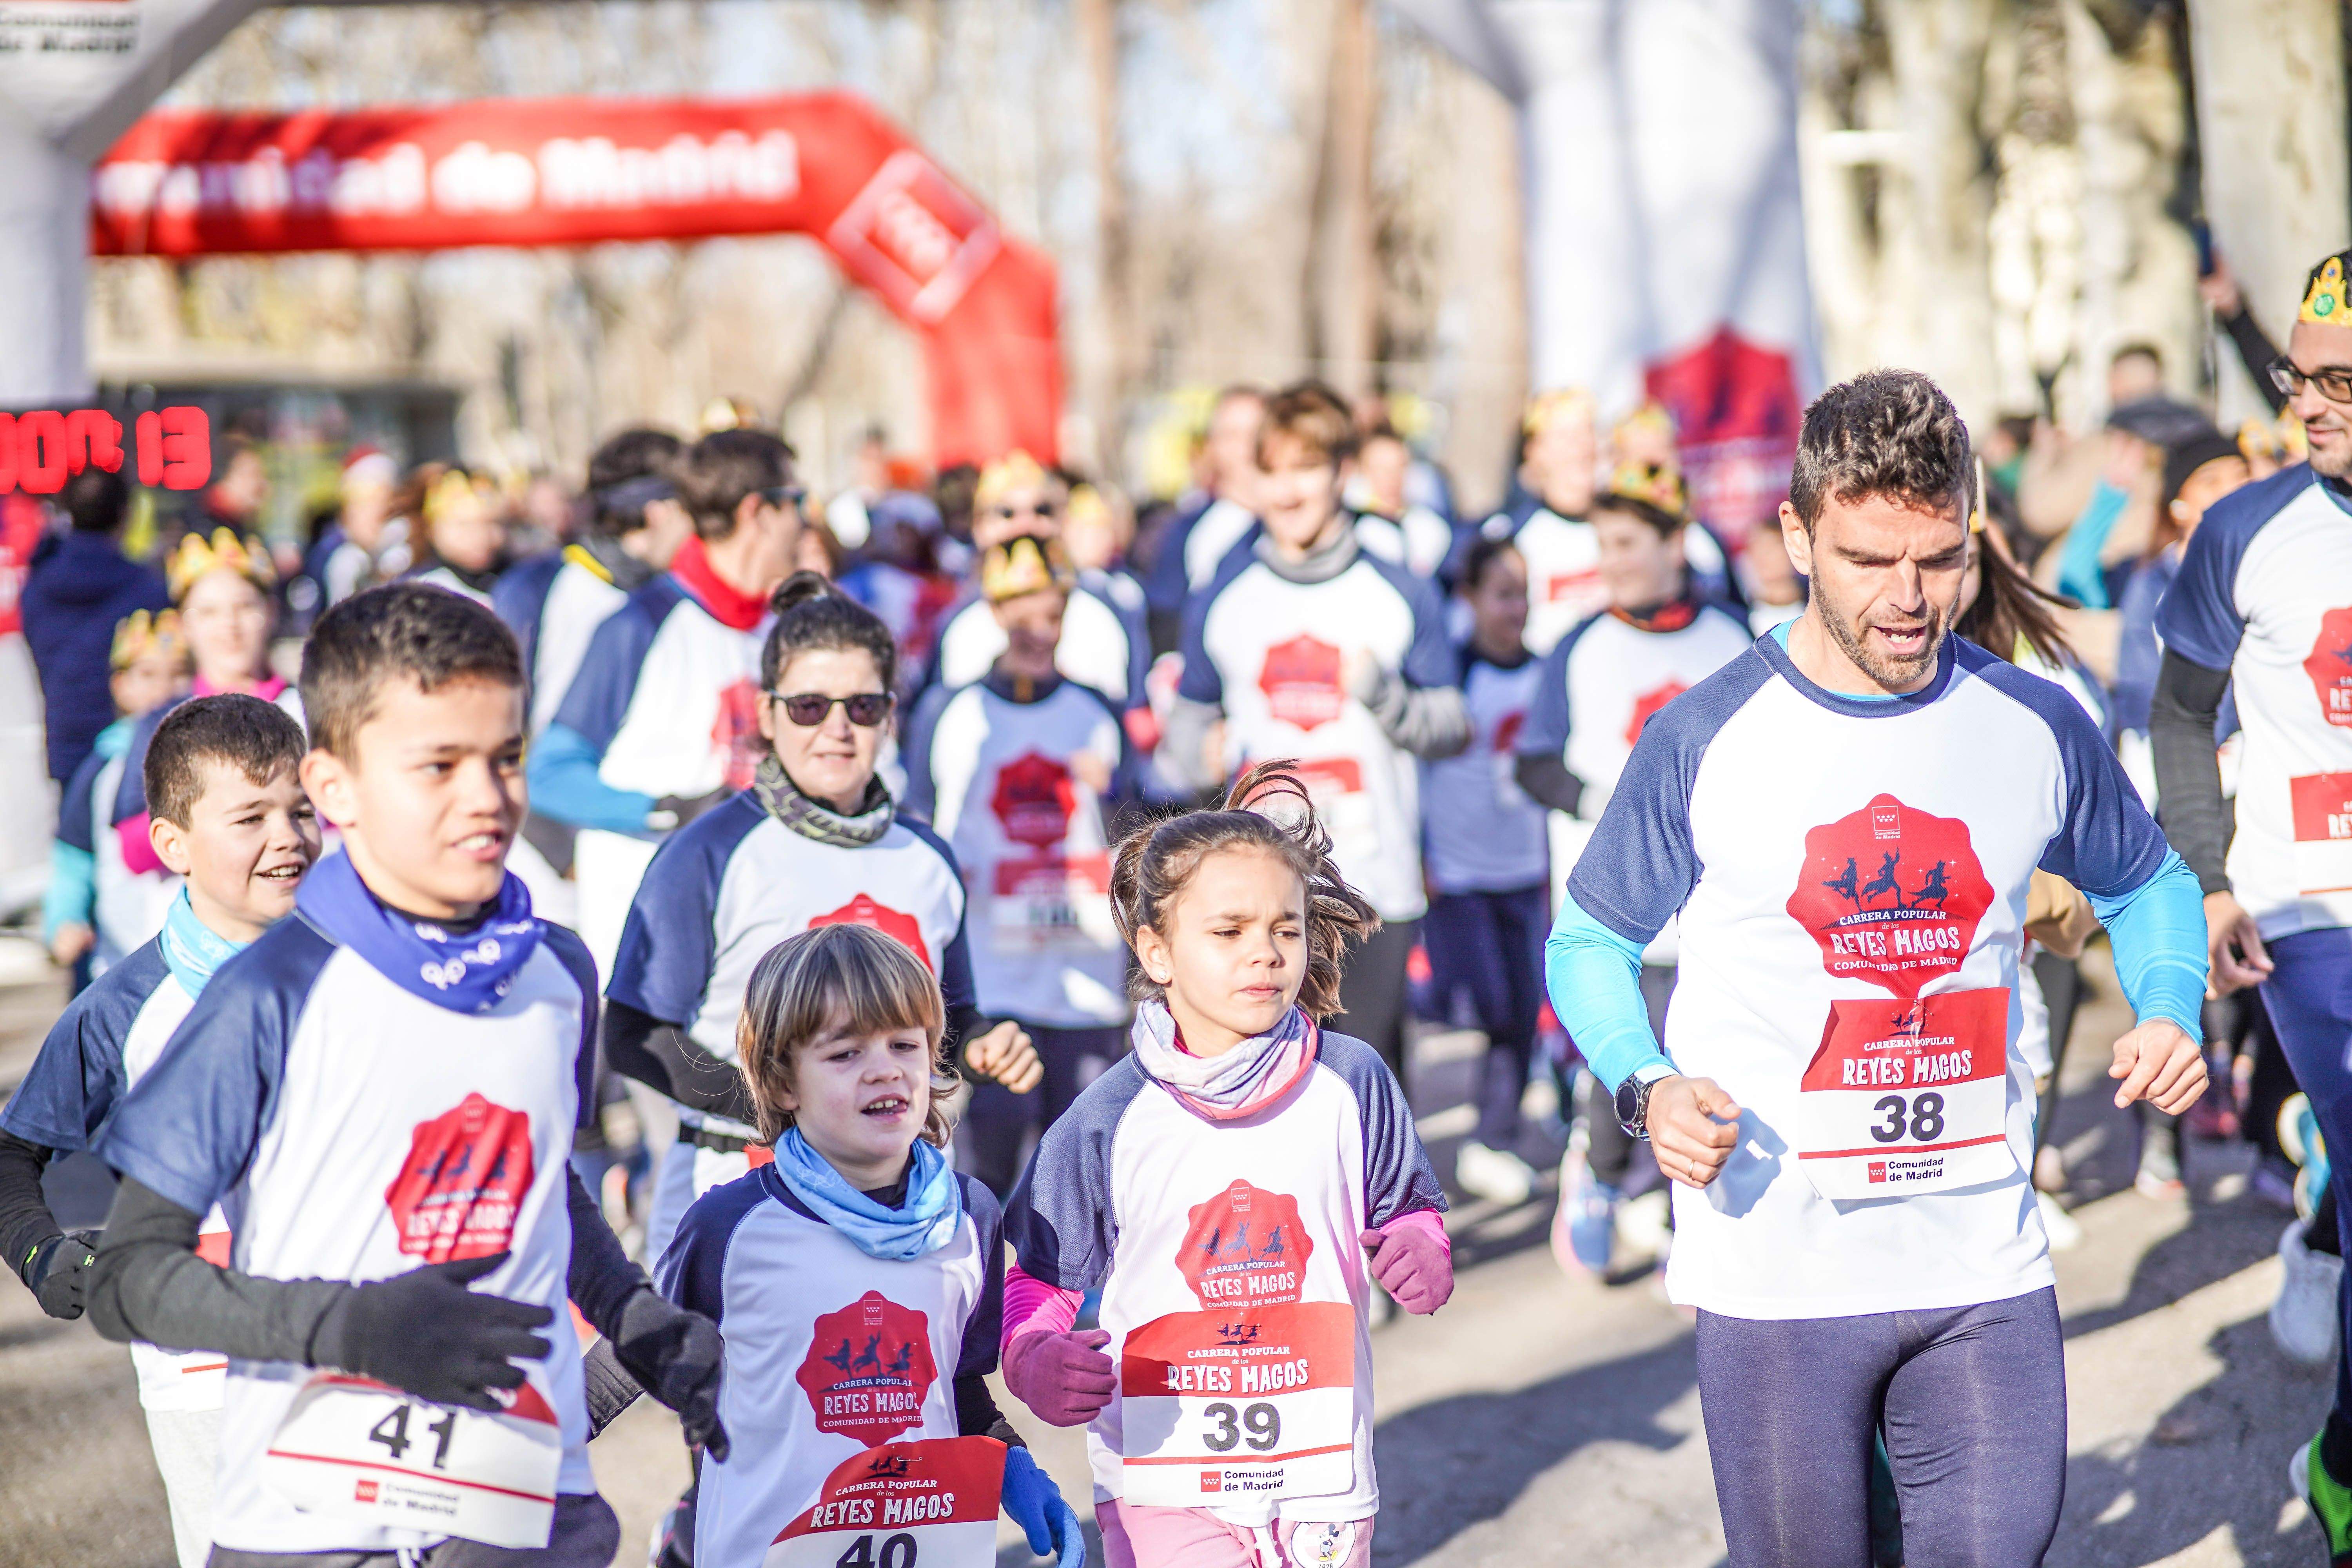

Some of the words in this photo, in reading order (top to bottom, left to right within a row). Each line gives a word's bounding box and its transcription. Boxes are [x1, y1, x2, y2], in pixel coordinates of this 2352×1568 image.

[2330, 688, 2352, 711] RE
[1839, 911, 1891, 926] CARRERA
[1894, 910, 1946, 920] POPULAR
[1829, 931, 1887, 956] REYES
[1893, 927, 1960, 955] MAGOS
[1834, 960, 1898, 971] COMUNIDAD
[1902, 960, 1917, 969] DE
[1920, 956, 1957, 967] MADRID
[1864, 1039, 1912, 1051] CARRERA
[1914, 1036, 1955, 1047] POPULAR
[1842, 1057, 1906, 1085] REYES
[1913, 1049, 1973, 1083] MAGOS
[1871, 1092, 1944, 1142] 38
[1889, 1158, 1943, 1169] Comunidad
[1889, 1173, 1902, 1181] de
[1906, 1169, 1942, 1180] Madrid
[406, 1208, 459, 1236] REYS
[1206, 1263, 1245, 1275] CARRERA
[1247, 1261, 1285, 1269] POPULAR
[1200, 1278, 1242, 1299] REYES
[1248, 1271, 1296, 1296] MAGOS
[1264, 1294, 1296, 1305] MADRID
[1187, 1349, 1239, 1358] CARRERA
[1242, 1346, 1290, 1356] POPULAR
[833, 1379, 873, 1390] CARRERA
[875, 1378, 913, 1387] POPULAR
[1167, 1365, 1232, 1392] REYES
[1241, 1359, 1308, 1393] MAGOS
[824, 1394, 869, 1415] REYES
[823, 1417, 875, 1427] COMUNIDAD
[1203, 1403, 1281, 1452] 39
[369, 1405, 456, 1469] 41
[1225, 1468, 1283, 1479] Comunidad
[835, 1481, 885, 1496] CARRERA
[888, 1480, 937, 1490] POPULAR
[1225, 1483, 1238, 1491] de
[1243, 1479, 1283, 1490] Madrid
[810, 1499, 875, 1528] REYES
[883, 1493, 954, 1525] MAGOS
[836, 1533, 918, 1568] 40
